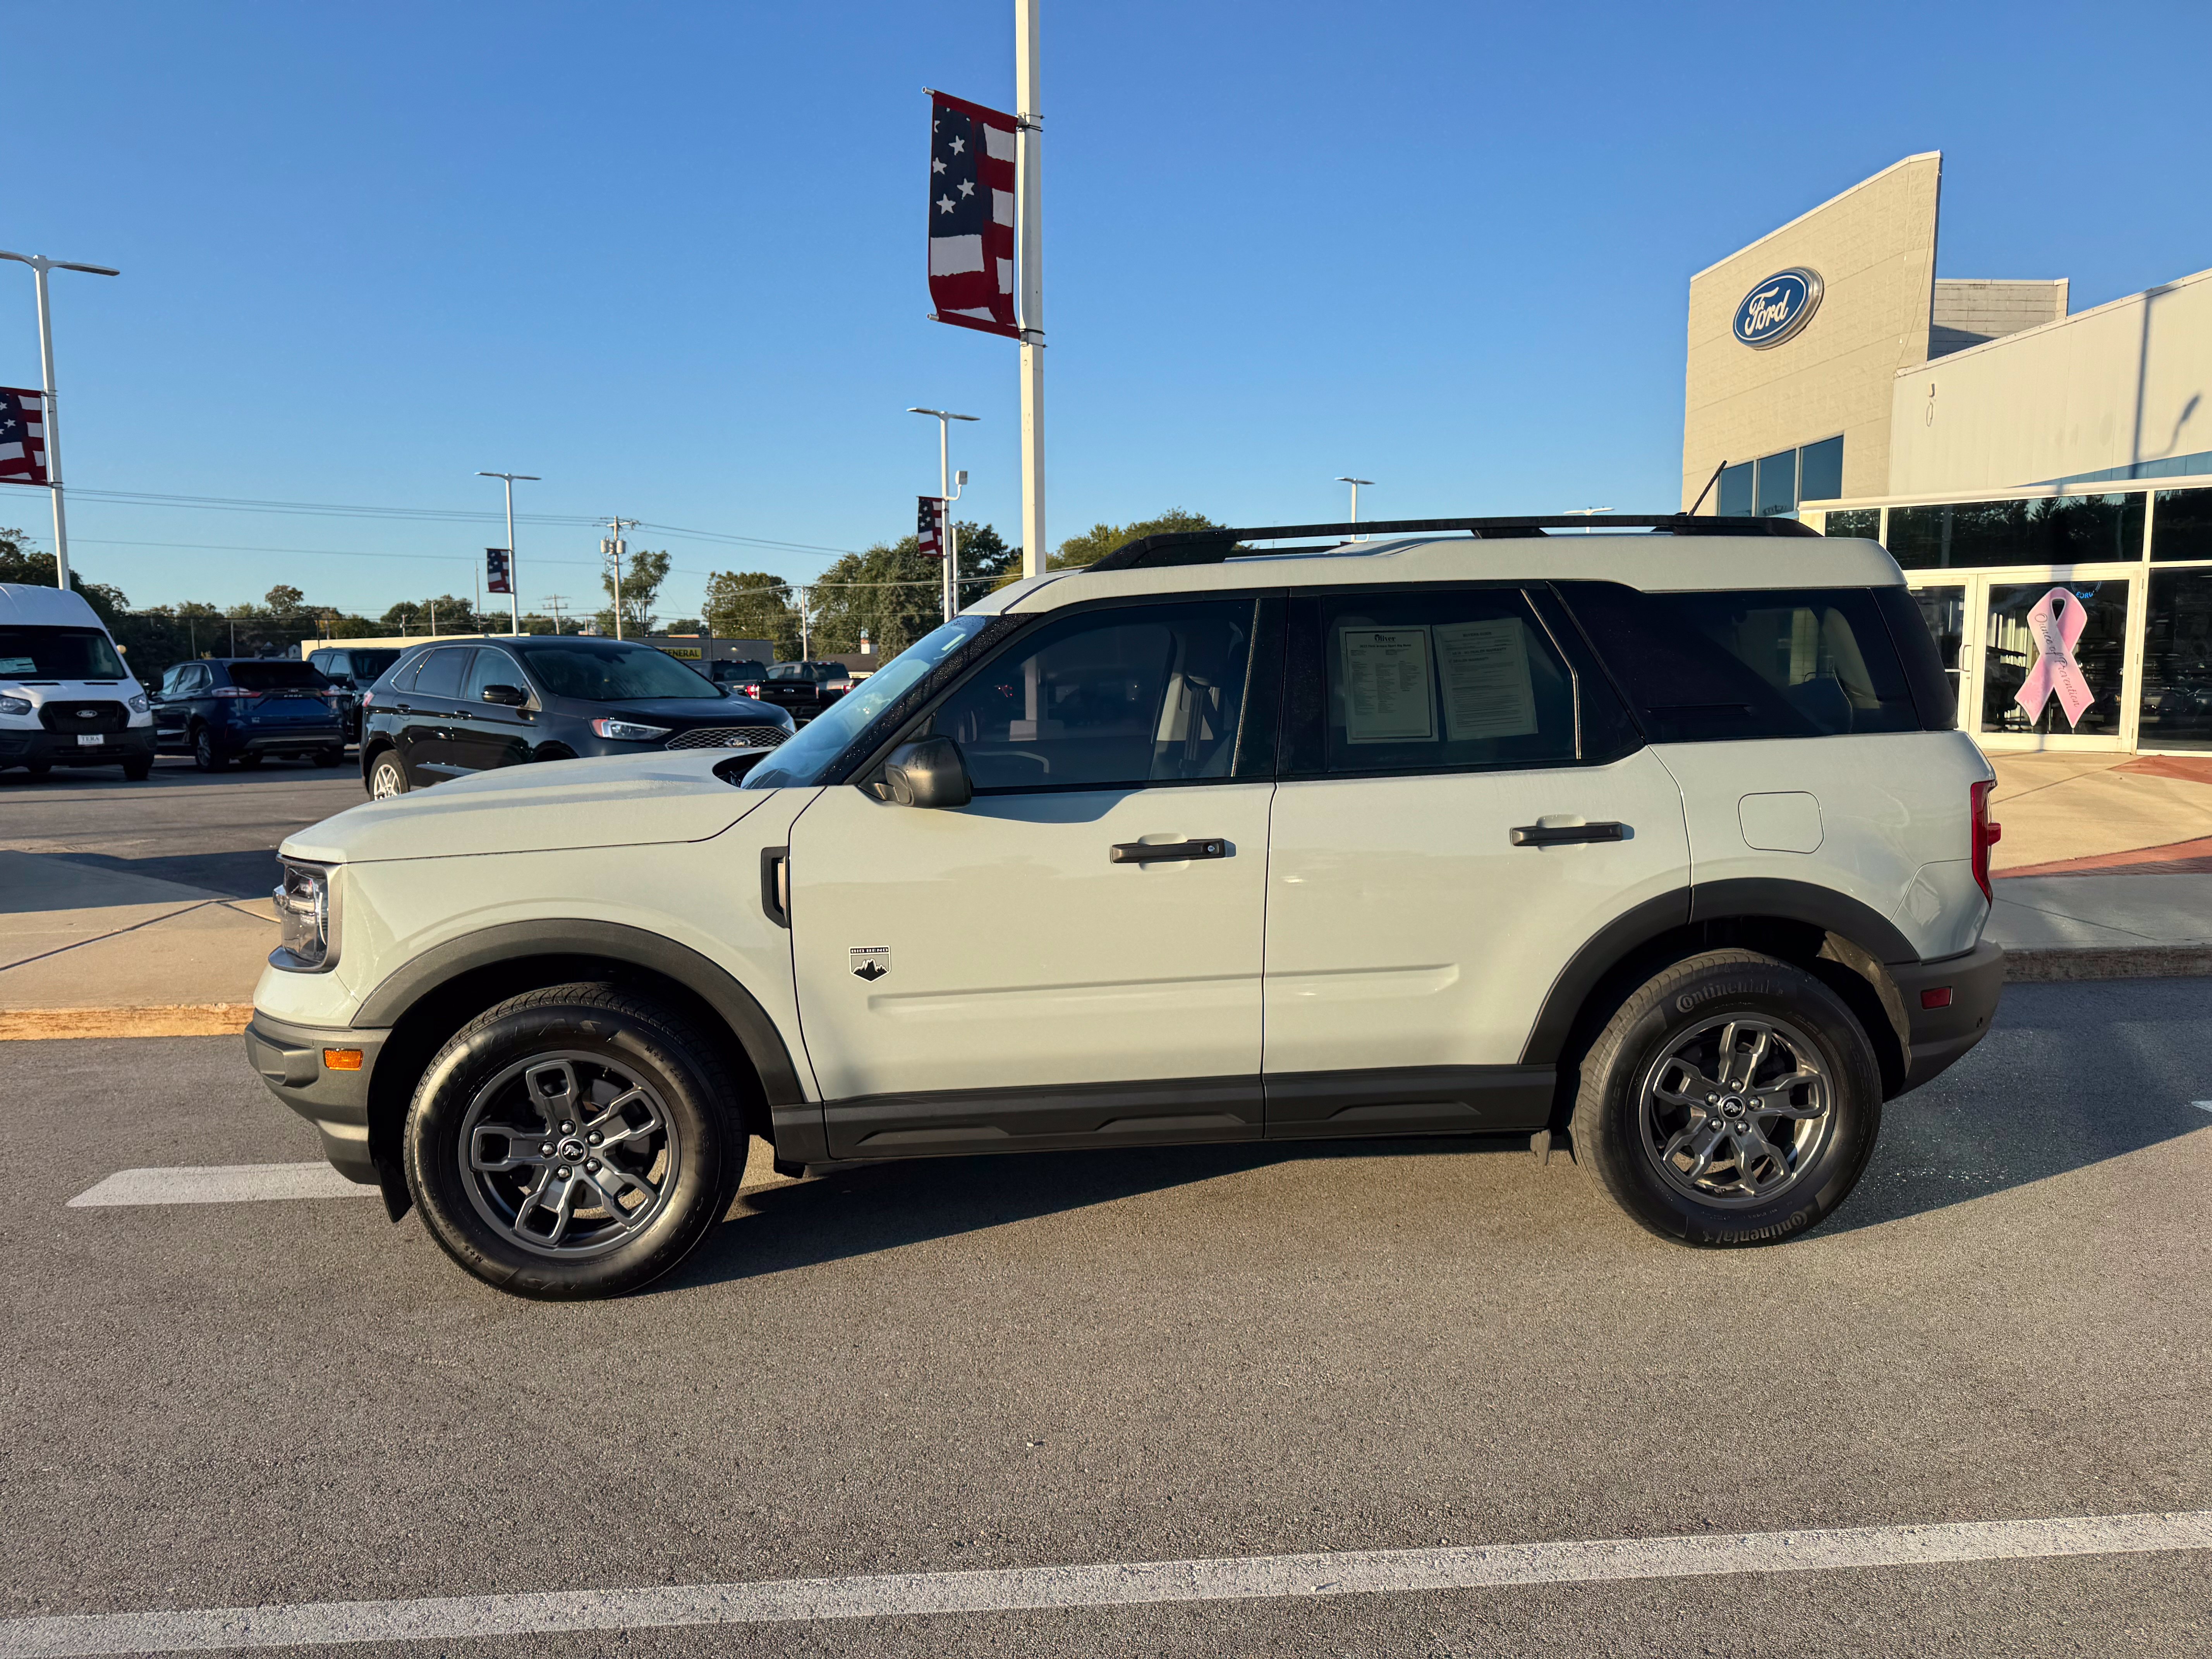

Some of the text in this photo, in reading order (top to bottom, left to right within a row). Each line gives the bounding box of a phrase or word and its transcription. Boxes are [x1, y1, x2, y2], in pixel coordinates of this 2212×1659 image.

[1744, 287, 1791, 336] Ford
[2035, 613, 2080, 708] Ounce of Prevention
[1716, 1211, 1807, 1244] Continental
